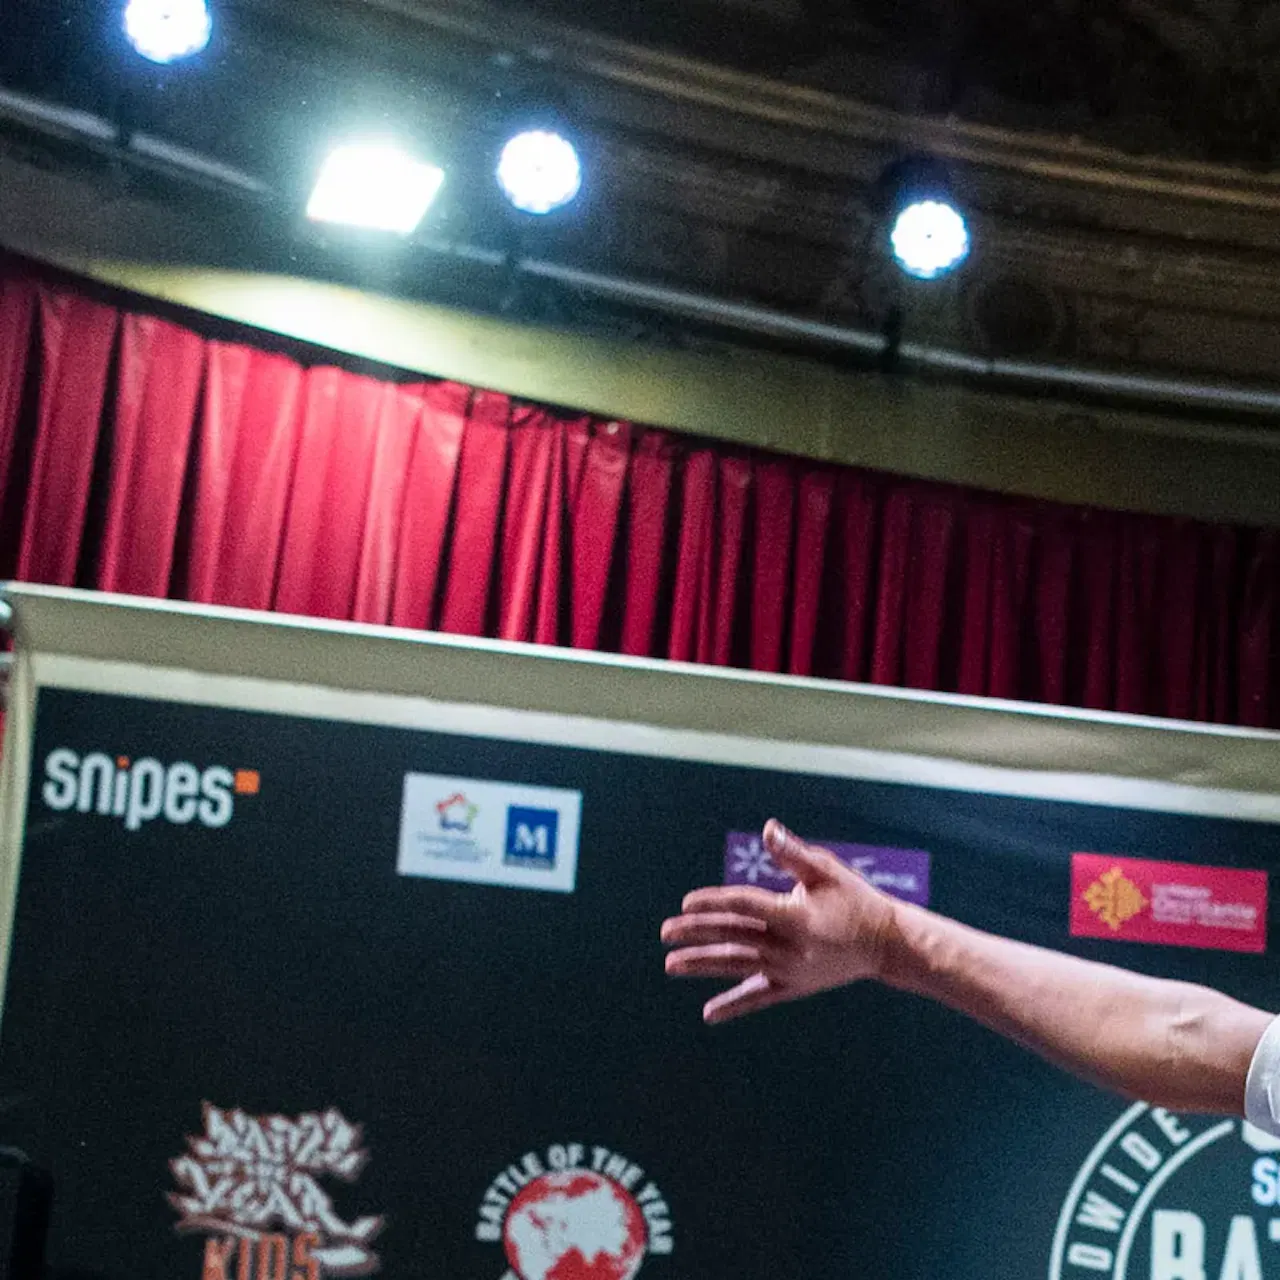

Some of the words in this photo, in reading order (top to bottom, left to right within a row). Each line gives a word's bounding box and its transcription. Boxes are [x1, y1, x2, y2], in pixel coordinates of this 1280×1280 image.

[43, 747, 235, 831] snipes
[515, 821, 549, 855] M
[475, 1151, 545, 1242] BATTLE
[547, 1143, 585, 1169] OF
[592, 1145, 646, 1189] THE
[636, 1181, 675, 1255] YEAR
